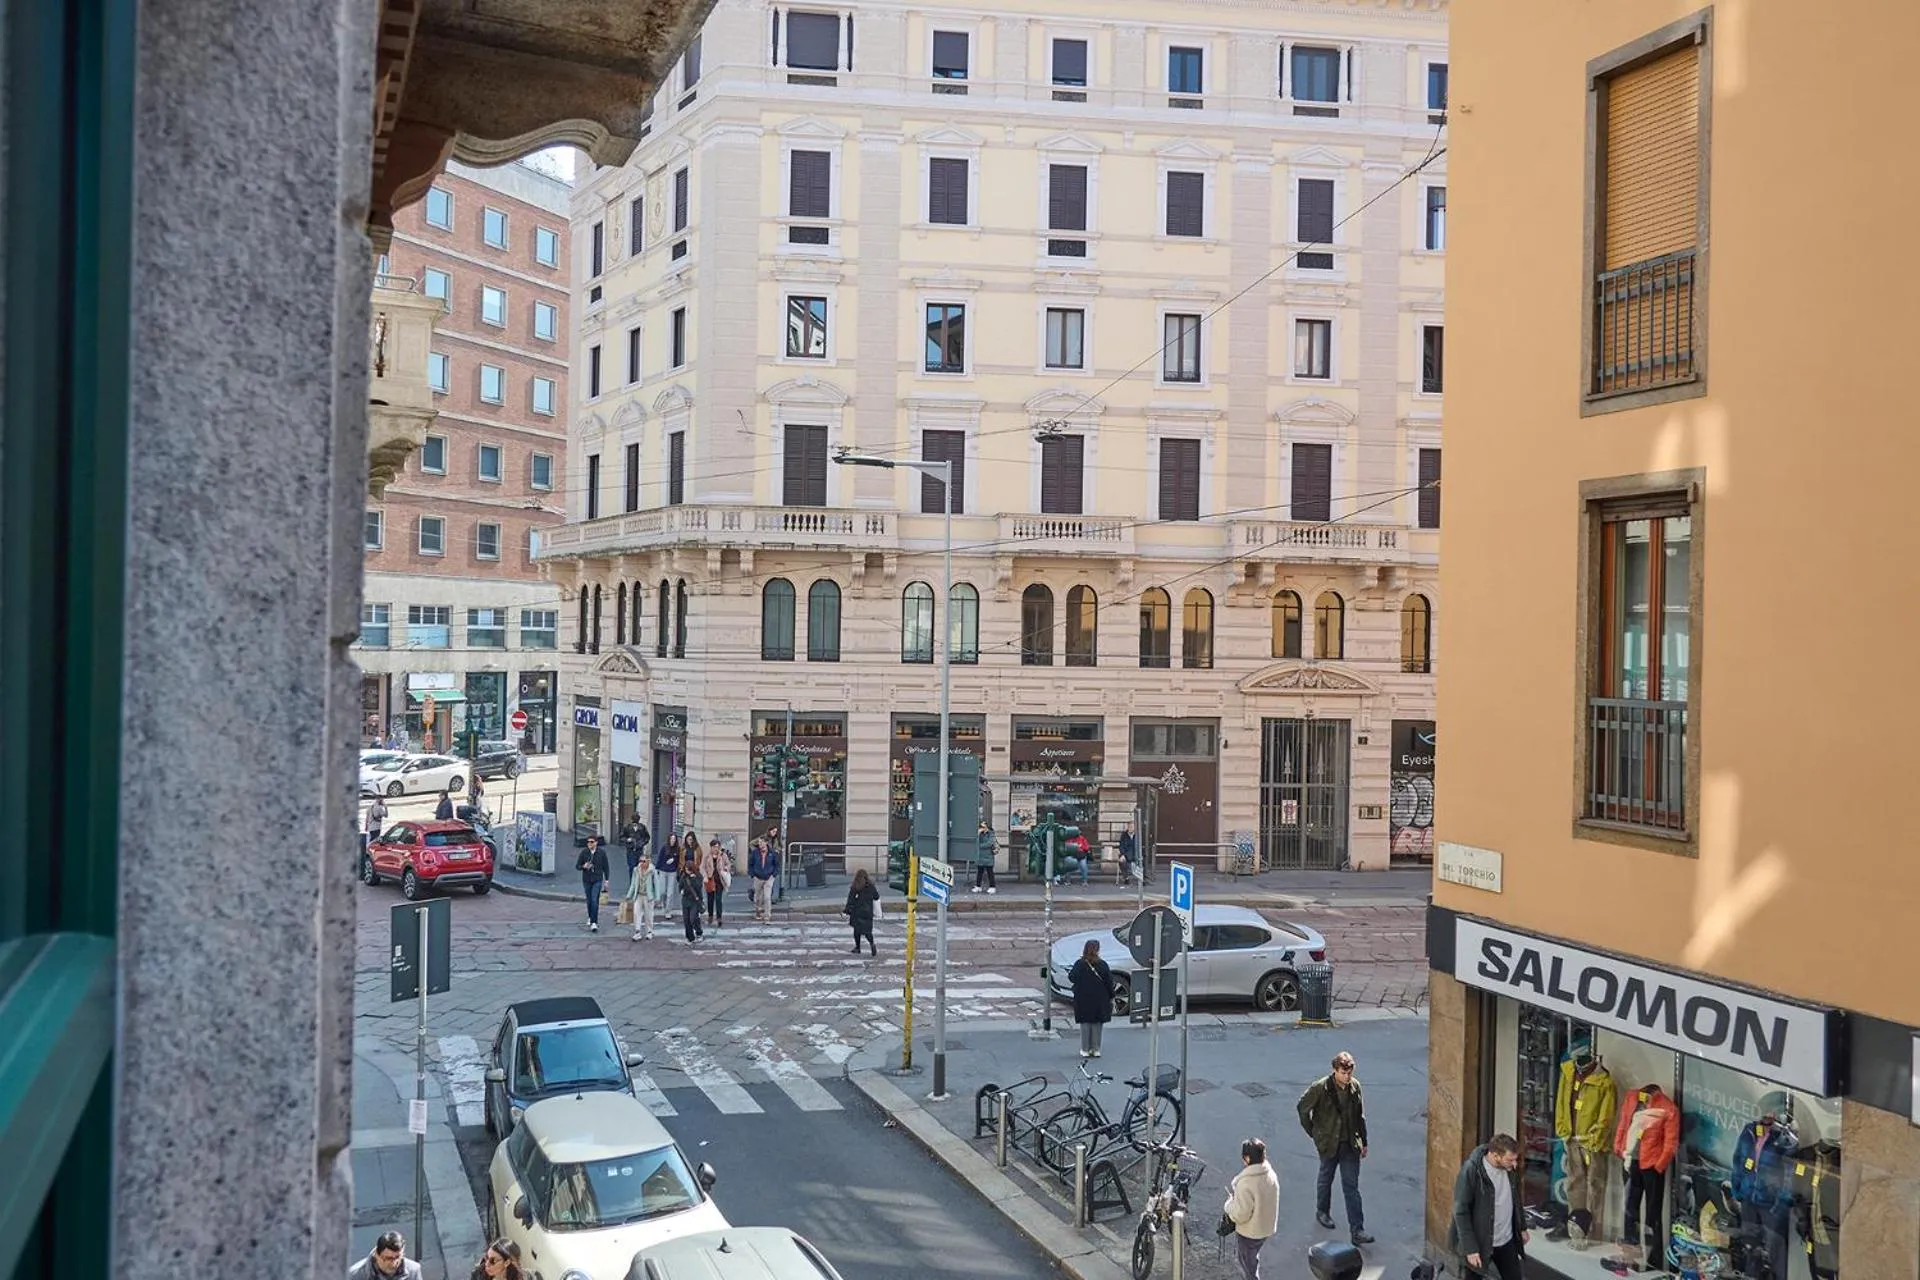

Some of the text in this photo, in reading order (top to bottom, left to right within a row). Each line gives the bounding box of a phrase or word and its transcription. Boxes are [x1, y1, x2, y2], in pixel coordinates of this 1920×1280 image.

[575, 708, 598, 727] GROM
[612, 713, 638, 733] GROM
[1458, 864, 1496, 882] TORCHIO
[1177, 873, 1188, 904] P
[1477, 937, 1790, 1068] SALOMON
